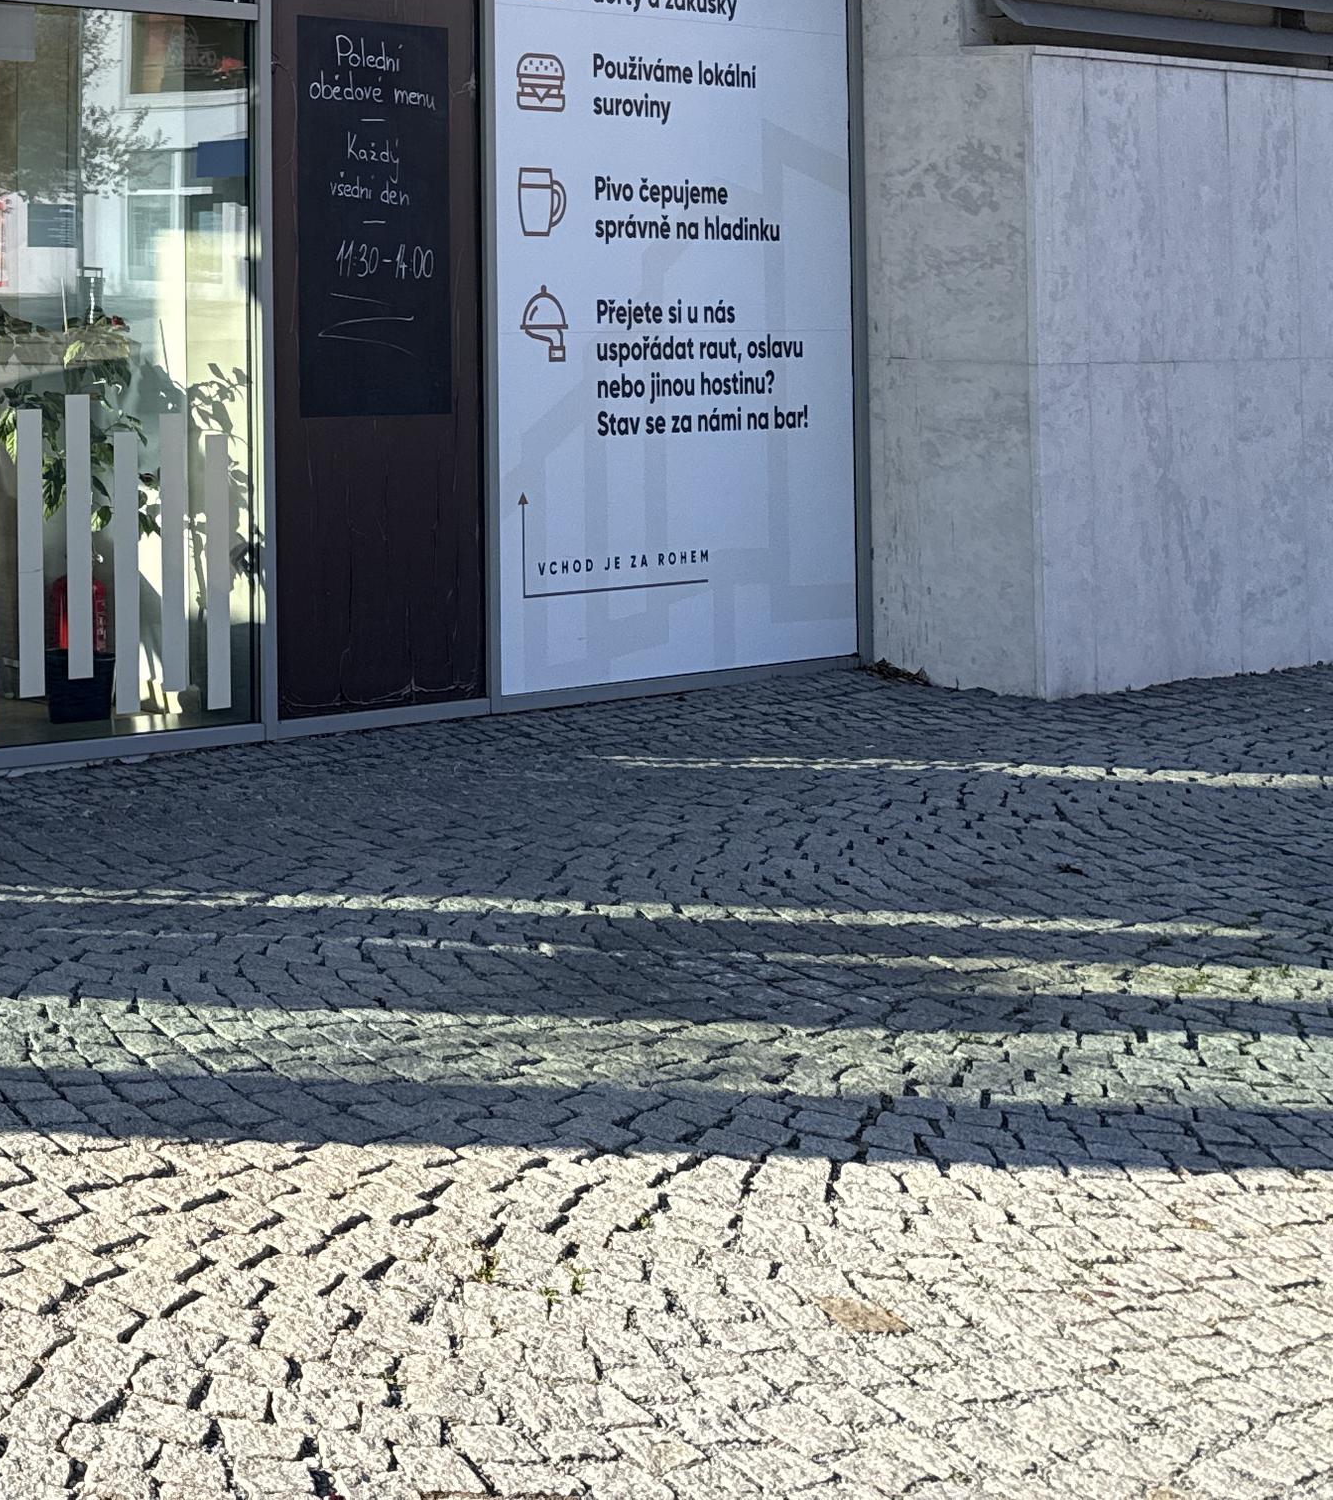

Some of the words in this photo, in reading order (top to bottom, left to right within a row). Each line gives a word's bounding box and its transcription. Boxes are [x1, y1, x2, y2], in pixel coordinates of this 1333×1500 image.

[334, 33, 404, 73] Polední
[591, 53, 693, 87] Používáme
[698, 56, 757, 90] lokální
[393, 87, 436, 112] menu
[592, 97, 671, 124] suroviny
[347, 130, 400, 184] Každý
[379, 180, 411, 206] den
[595, 175, 634, 203] Pivo
[638, 176, 729, 209] čepujeme
[594, 213, 671, 244] správně
[676, 220, 699, 241] na
[704, 216, 780, 243] hladinku
[596, 299, 663, 329] Přejete
[669, 300, 684, 325] si
[689, 306, 700, 325] u
[704, 301, 735, 325] nás
[596, 333, 694, 367] uspořádat
[699, 335, 743, 365] raut,
[747, 334, 804, 361] oslavu
[596, 374, 645, 400] nebo
[650, 372, 695, 401] jinou
[699, 369, 776, 396] hostinu?
[597, 410, 640, 437] Stav
[645, 414, 666, 435] se
[671, 413, 692, 434] za
[697, 407, 742, 434] námi
[747, 411, 769, 432] na
[774, 407, 809, 431] bar!
[538, 558, 594, 577] VCHOD
[604, 556, 622, 571] JE
[630, 554, 649, 569] ZA
[658, 549, 710, 566] ROHEM
